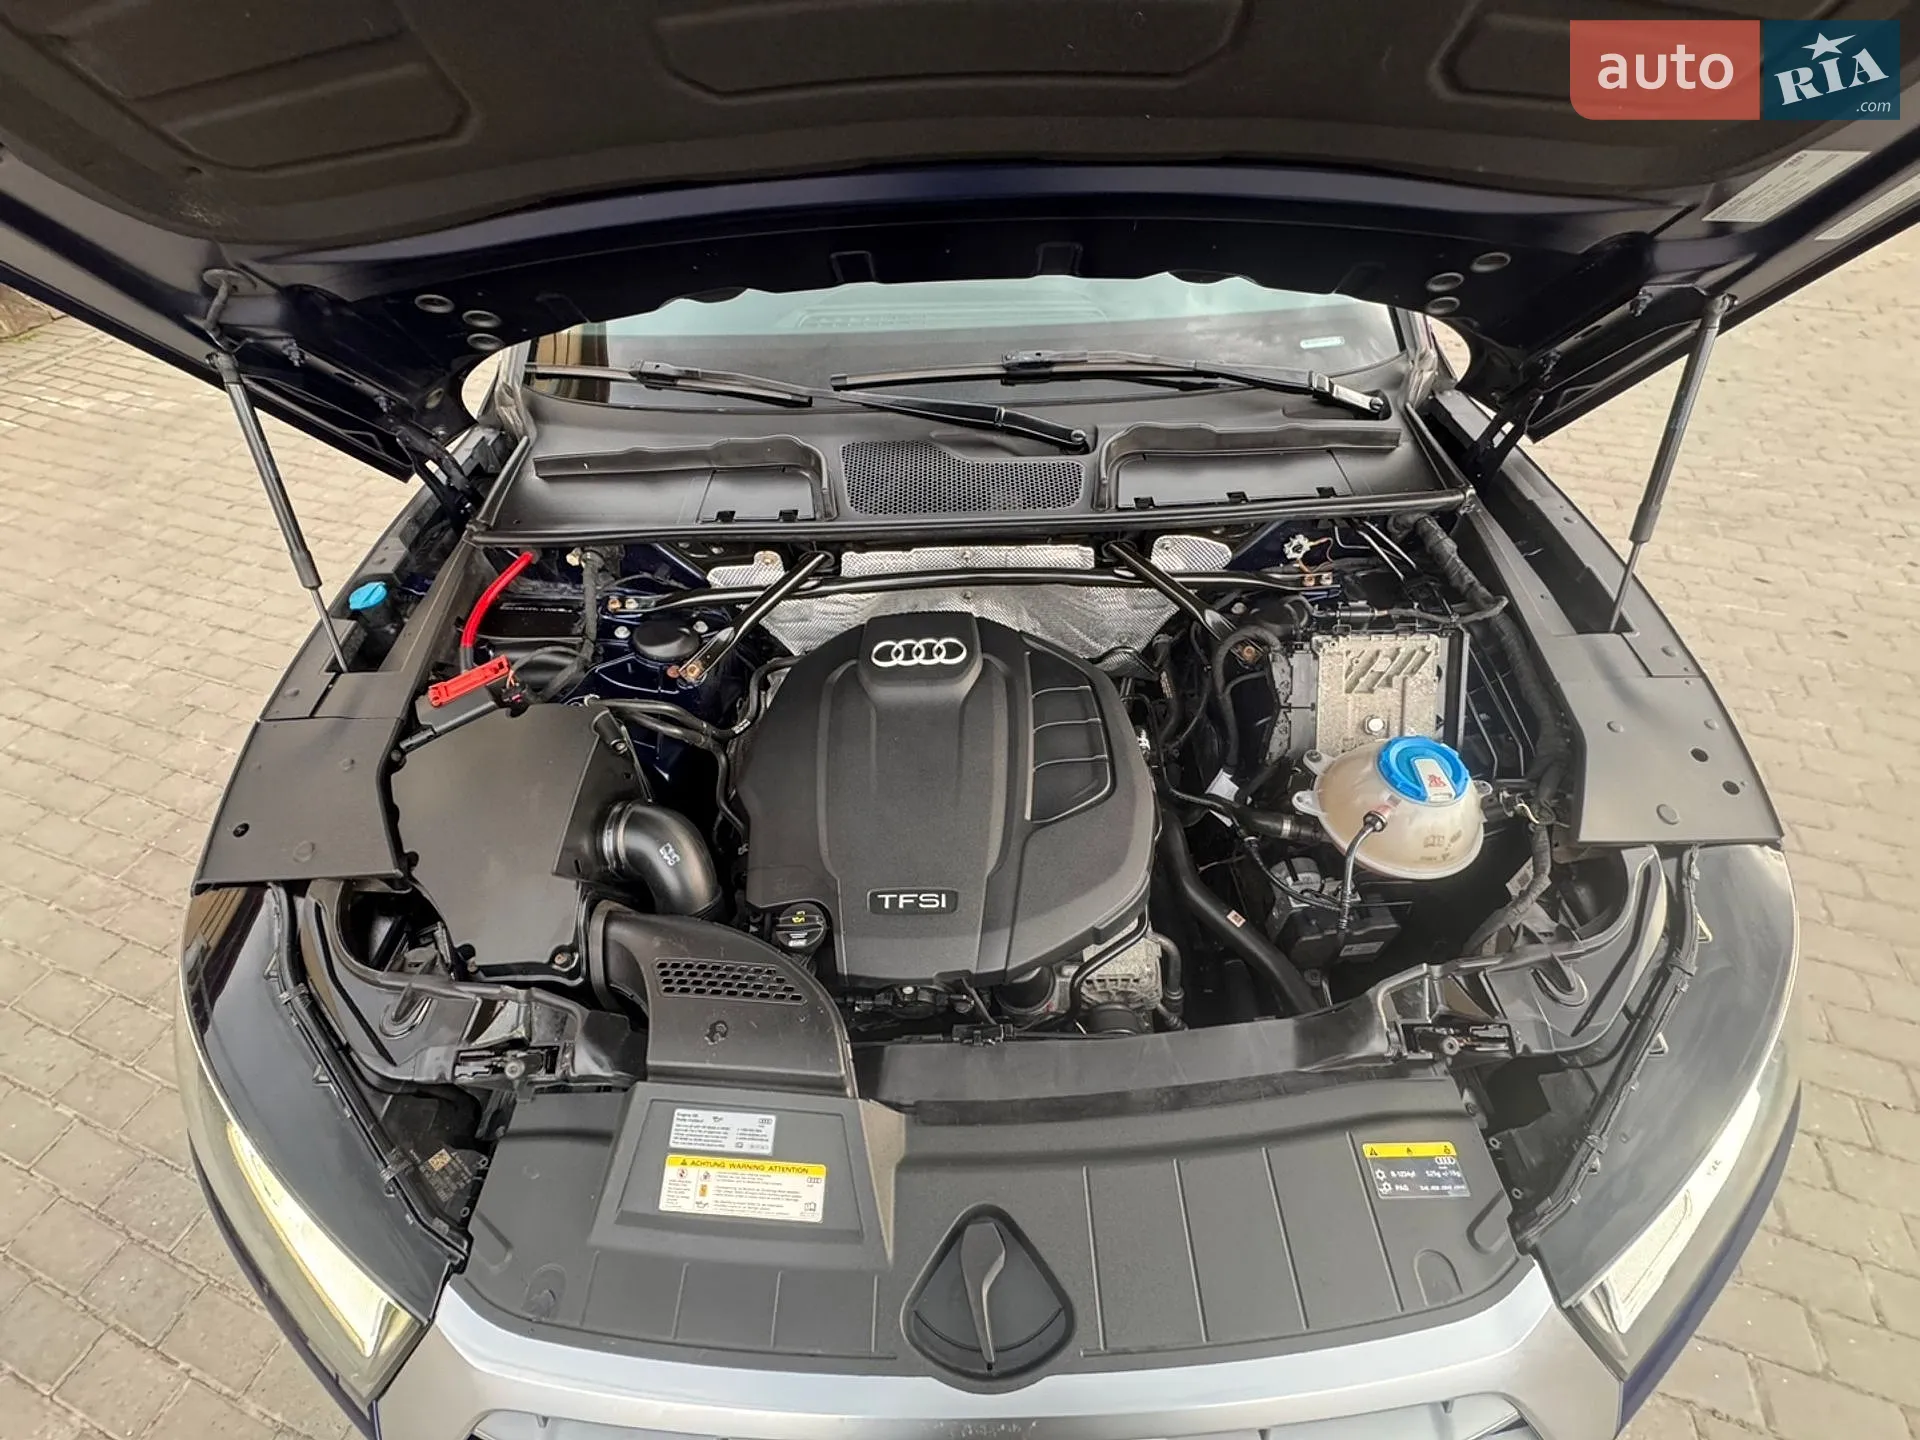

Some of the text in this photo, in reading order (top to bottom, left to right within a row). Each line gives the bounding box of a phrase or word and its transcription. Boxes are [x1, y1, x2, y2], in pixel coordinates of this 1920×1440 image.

[877, 893, 947, 909] TFSI
[690, 1160, 809, 1174] ACHTUNG WARNING ATTENTION
